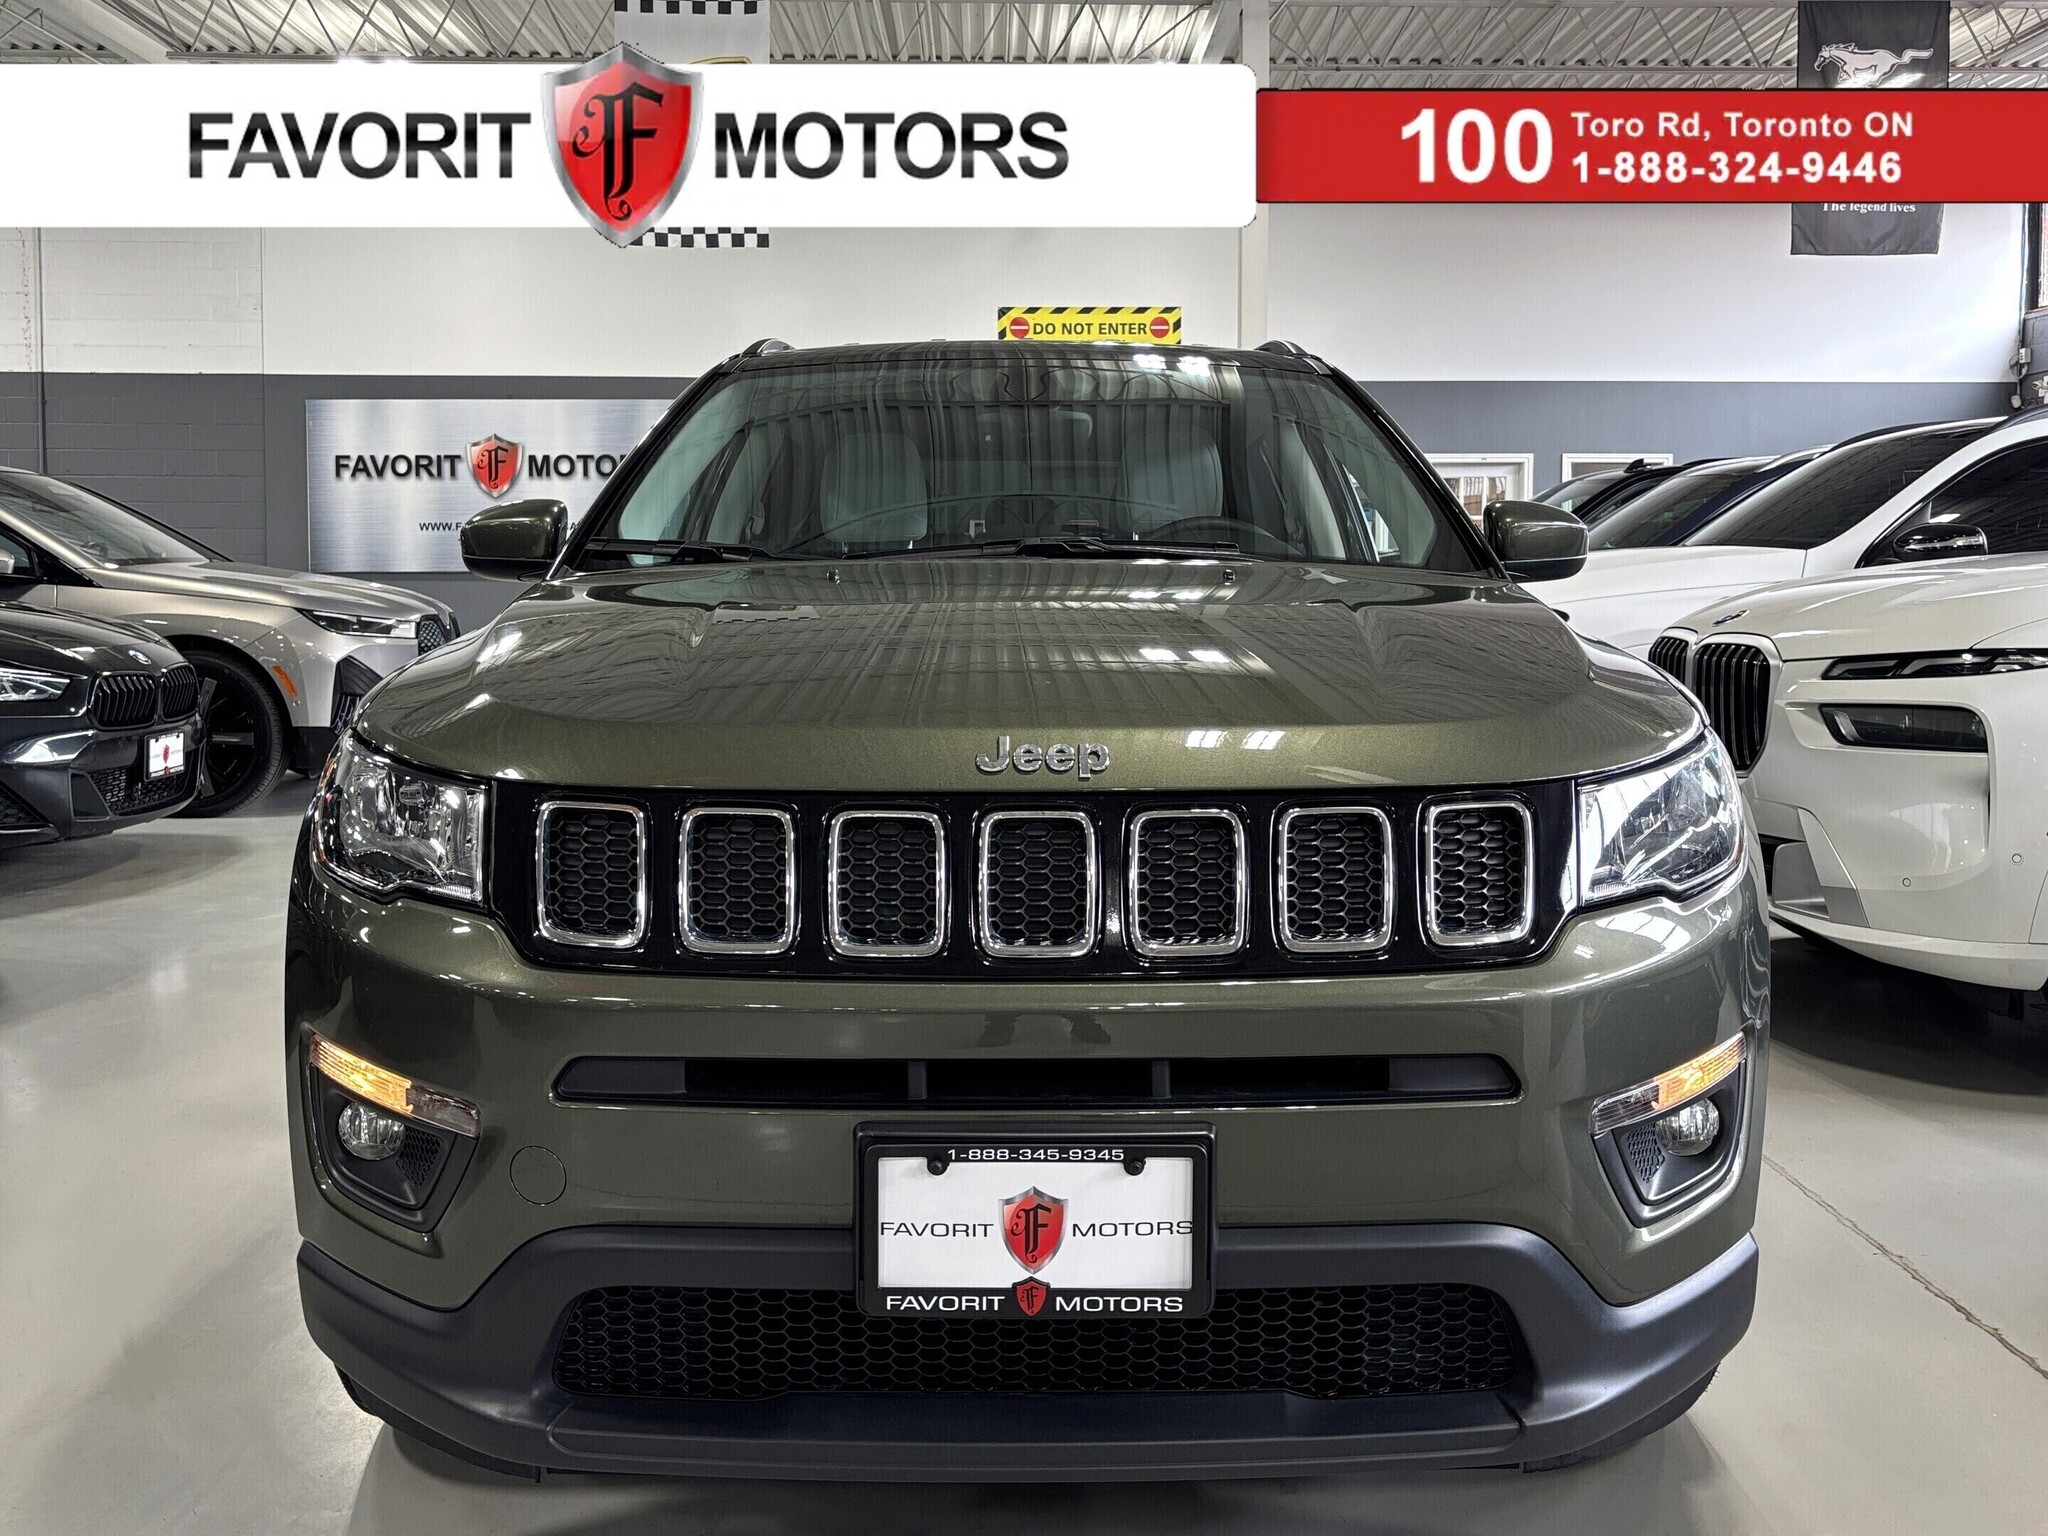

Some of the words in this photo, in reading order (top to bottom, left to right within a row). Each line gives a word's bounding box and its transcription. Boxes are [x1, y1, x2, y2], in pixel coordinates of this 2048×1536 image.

[1822, 202, 1847, 213] The
[1849, 202, 1887, 214] legend
[1889, 203, 1916, 213] lives
[1033, 322, 1056, 335] DO
[1061, 322, 1094, 335] NOT
[1098, 322, 1147, 335] ENTER
[335, 454, 462, 478] FAVORIT
[975, 735, 1111, 781] Jeep
[947, 1149, 1124, 1161] 1-888-345-9345
[880, 1221, 995, 1238] FAVORIT
[1072, 1220, 1194, 1238] MOTORS
[886, 1295, 1006, 1312] FAVORIT
[1055, 1296, 1183, 1313] MOTORS
